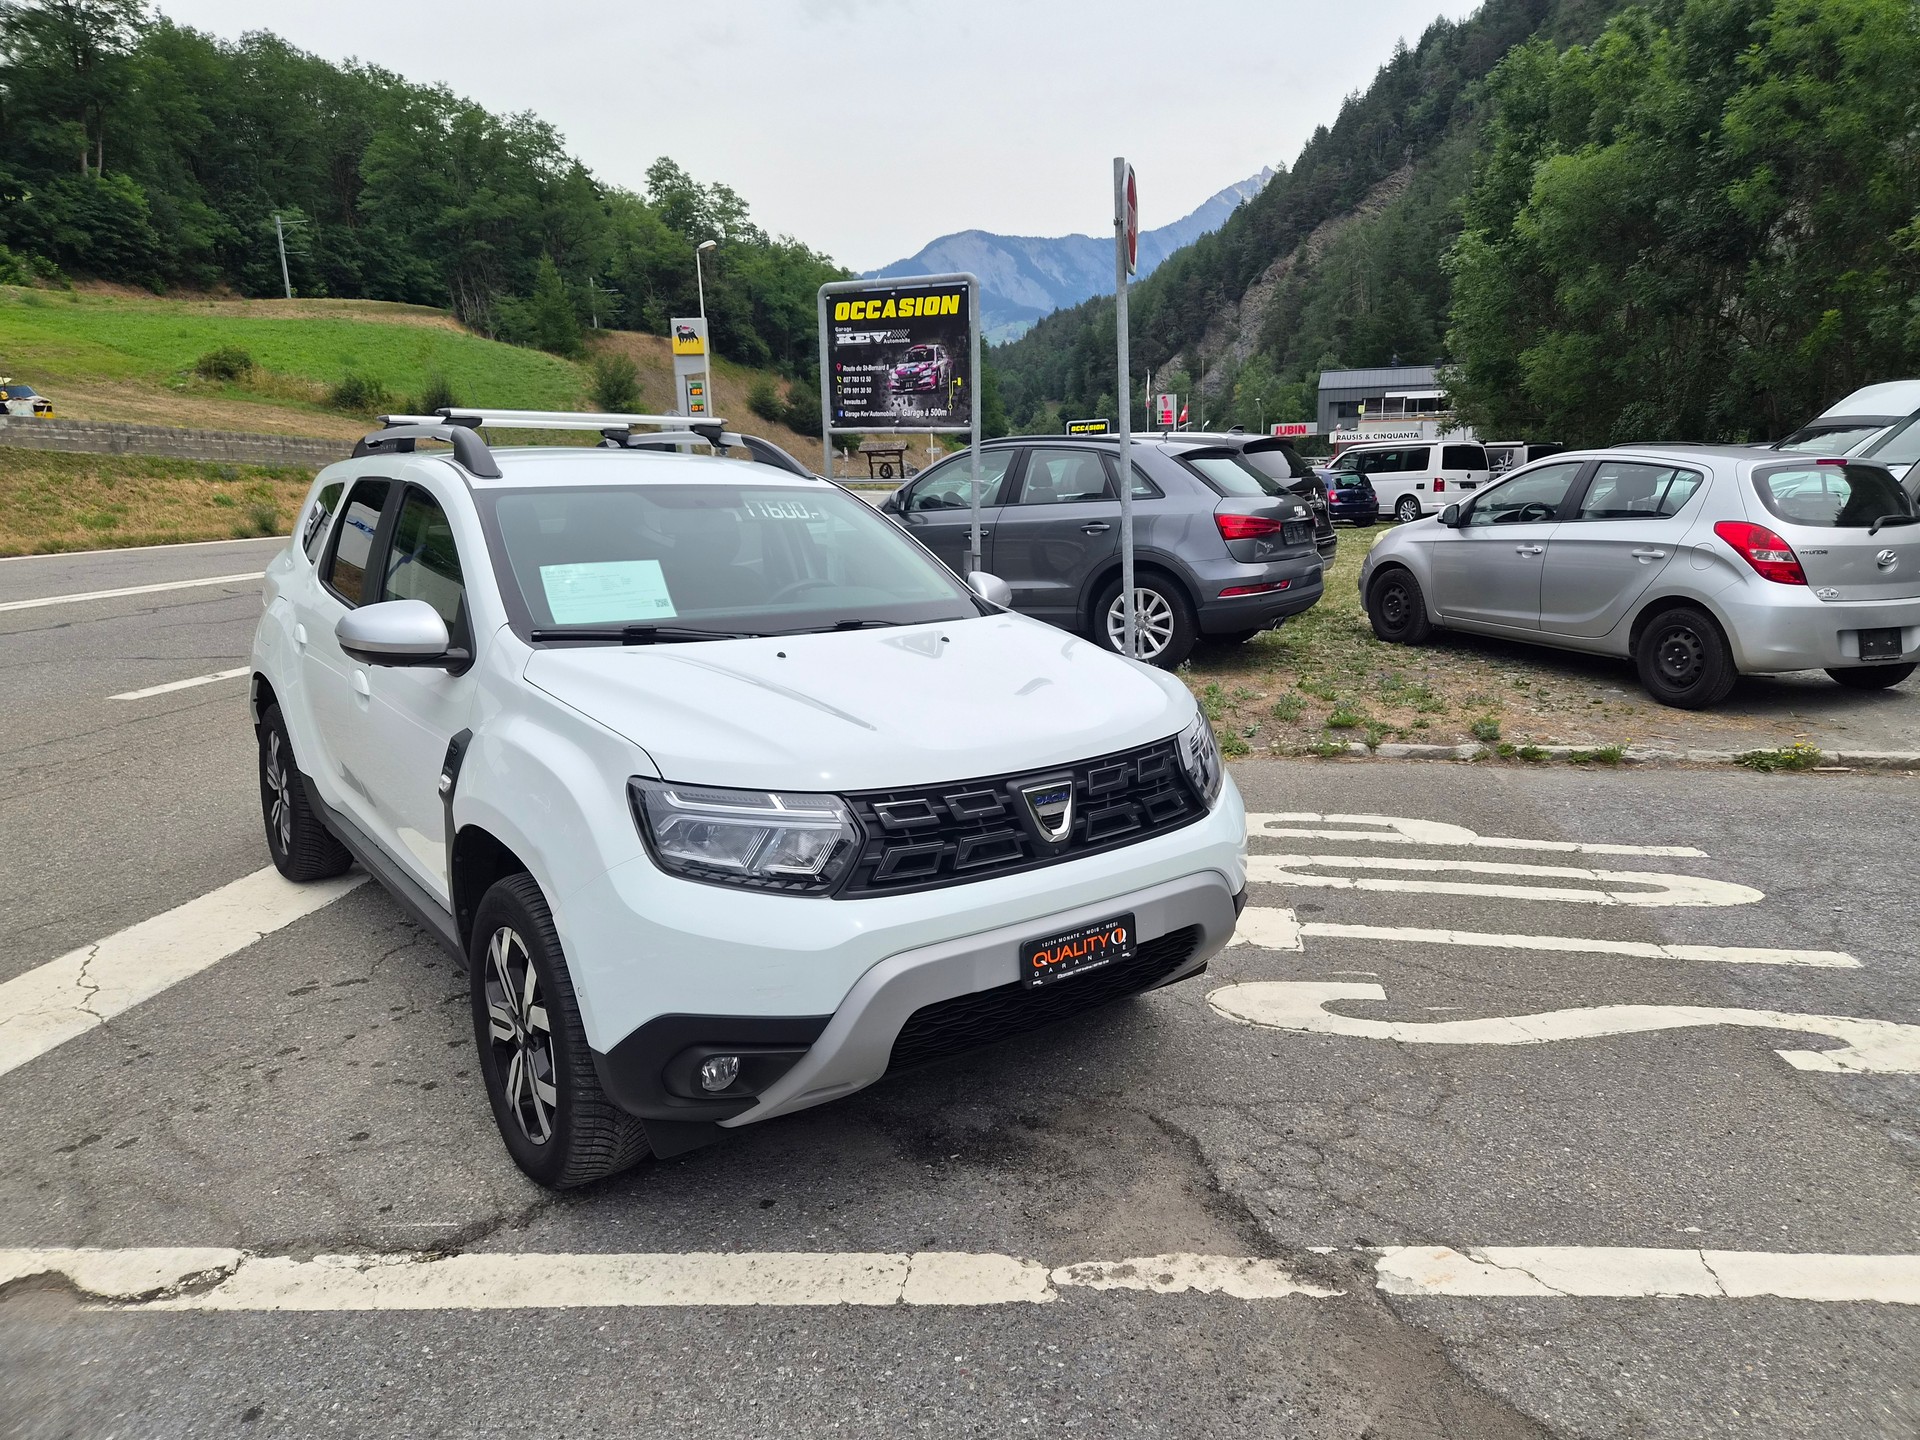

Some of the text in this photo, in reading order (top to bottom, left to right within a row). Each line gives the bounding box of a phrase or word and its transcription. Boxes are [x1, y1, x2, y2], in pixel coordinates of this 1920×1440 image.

[834, 294, 960, 321] OCCASION
[845, 410, 860, 418] Garage
[902, 408, 924, 419] Garage
[930, 408, 948, 417] 500m
[1071, 423, 1106, 432] OCCASION
[1275, 425, 1307, 435] JUBIN
[1337, 433, 1363, 441] RAUSIS
[1373, 432, 1420, 441] CINQUANTA
[1034, 791, 1068, 806] DACIA
[1058, 932, 1080, 943] MONATE
[1086, 926, 1099, 935] MOIS
[1105, 921, 1118, 930] MESI
[1032, 932, 1110, 968] QUALITY
